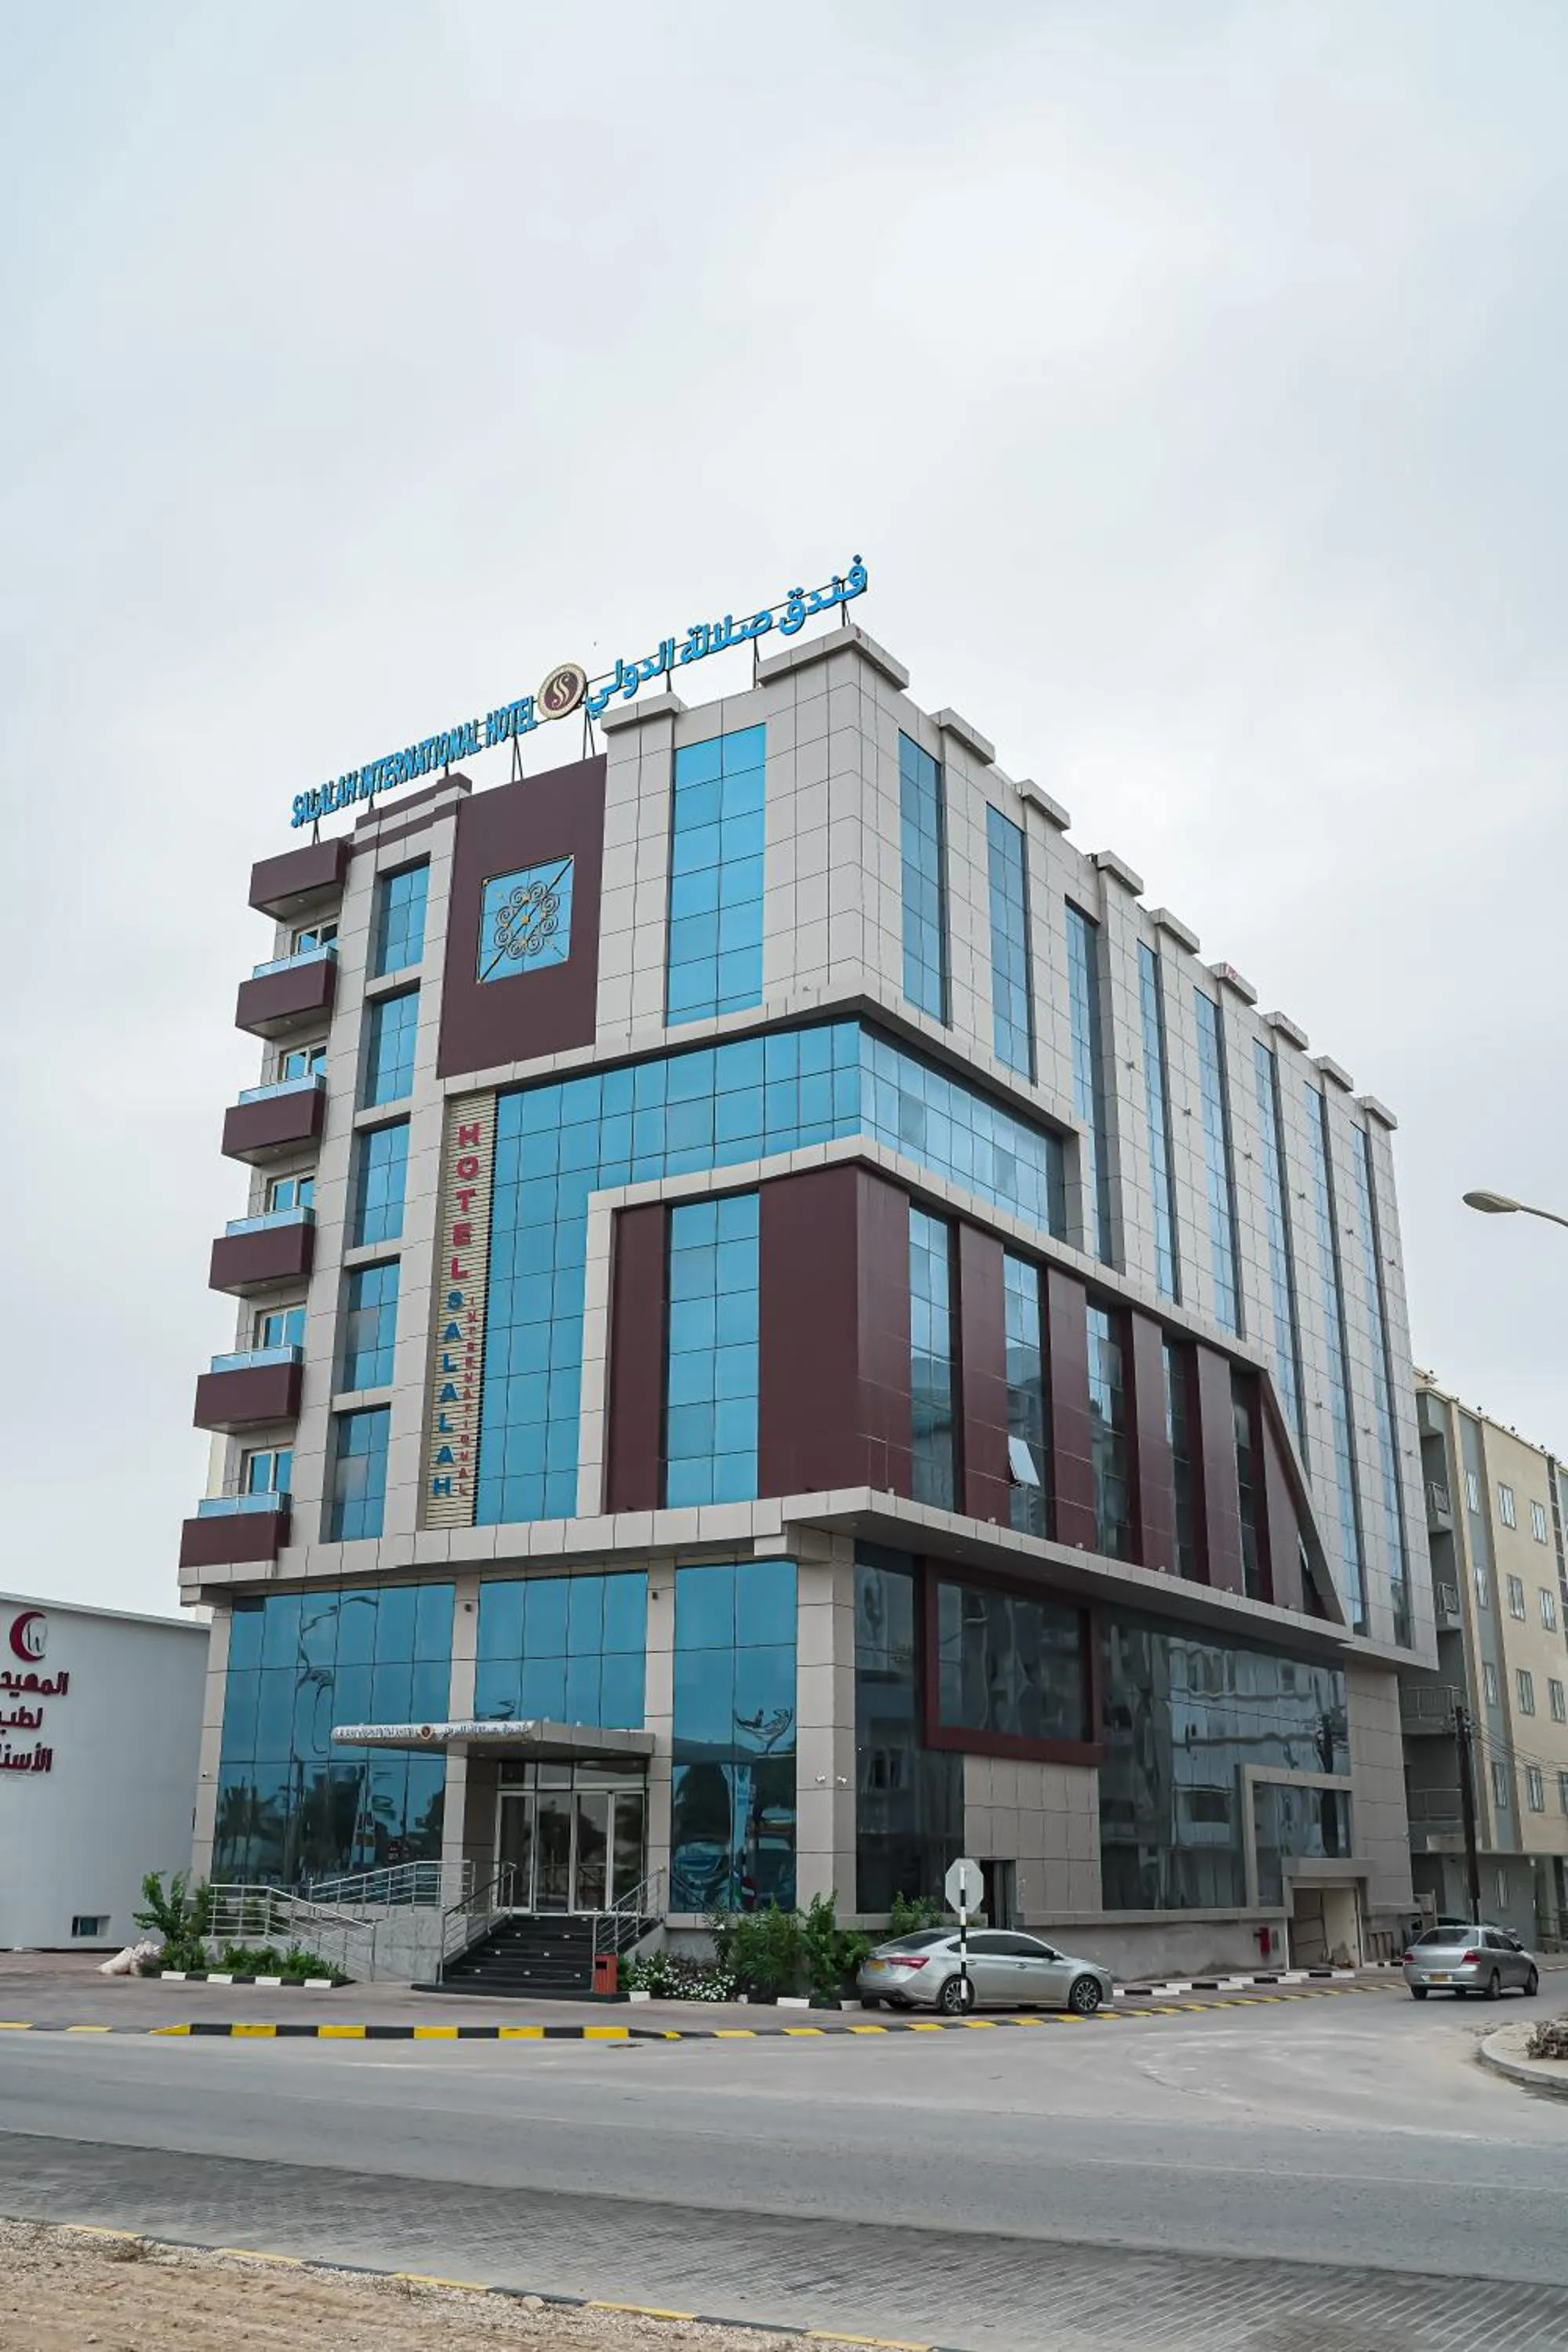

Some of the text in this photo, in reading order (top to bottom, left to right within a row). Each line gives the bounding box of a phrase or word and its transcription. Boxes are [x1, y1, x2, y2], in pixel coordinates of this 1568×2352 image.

[586, 554, 868, 720] فندق صلالة الدولي
[291, 695, 538, 828] SALALAH INTERNATIONAL HOTEL
[451, 1122, 481, 1279] HOTEL
[433, 1290, 464, 1497] SALALAH
